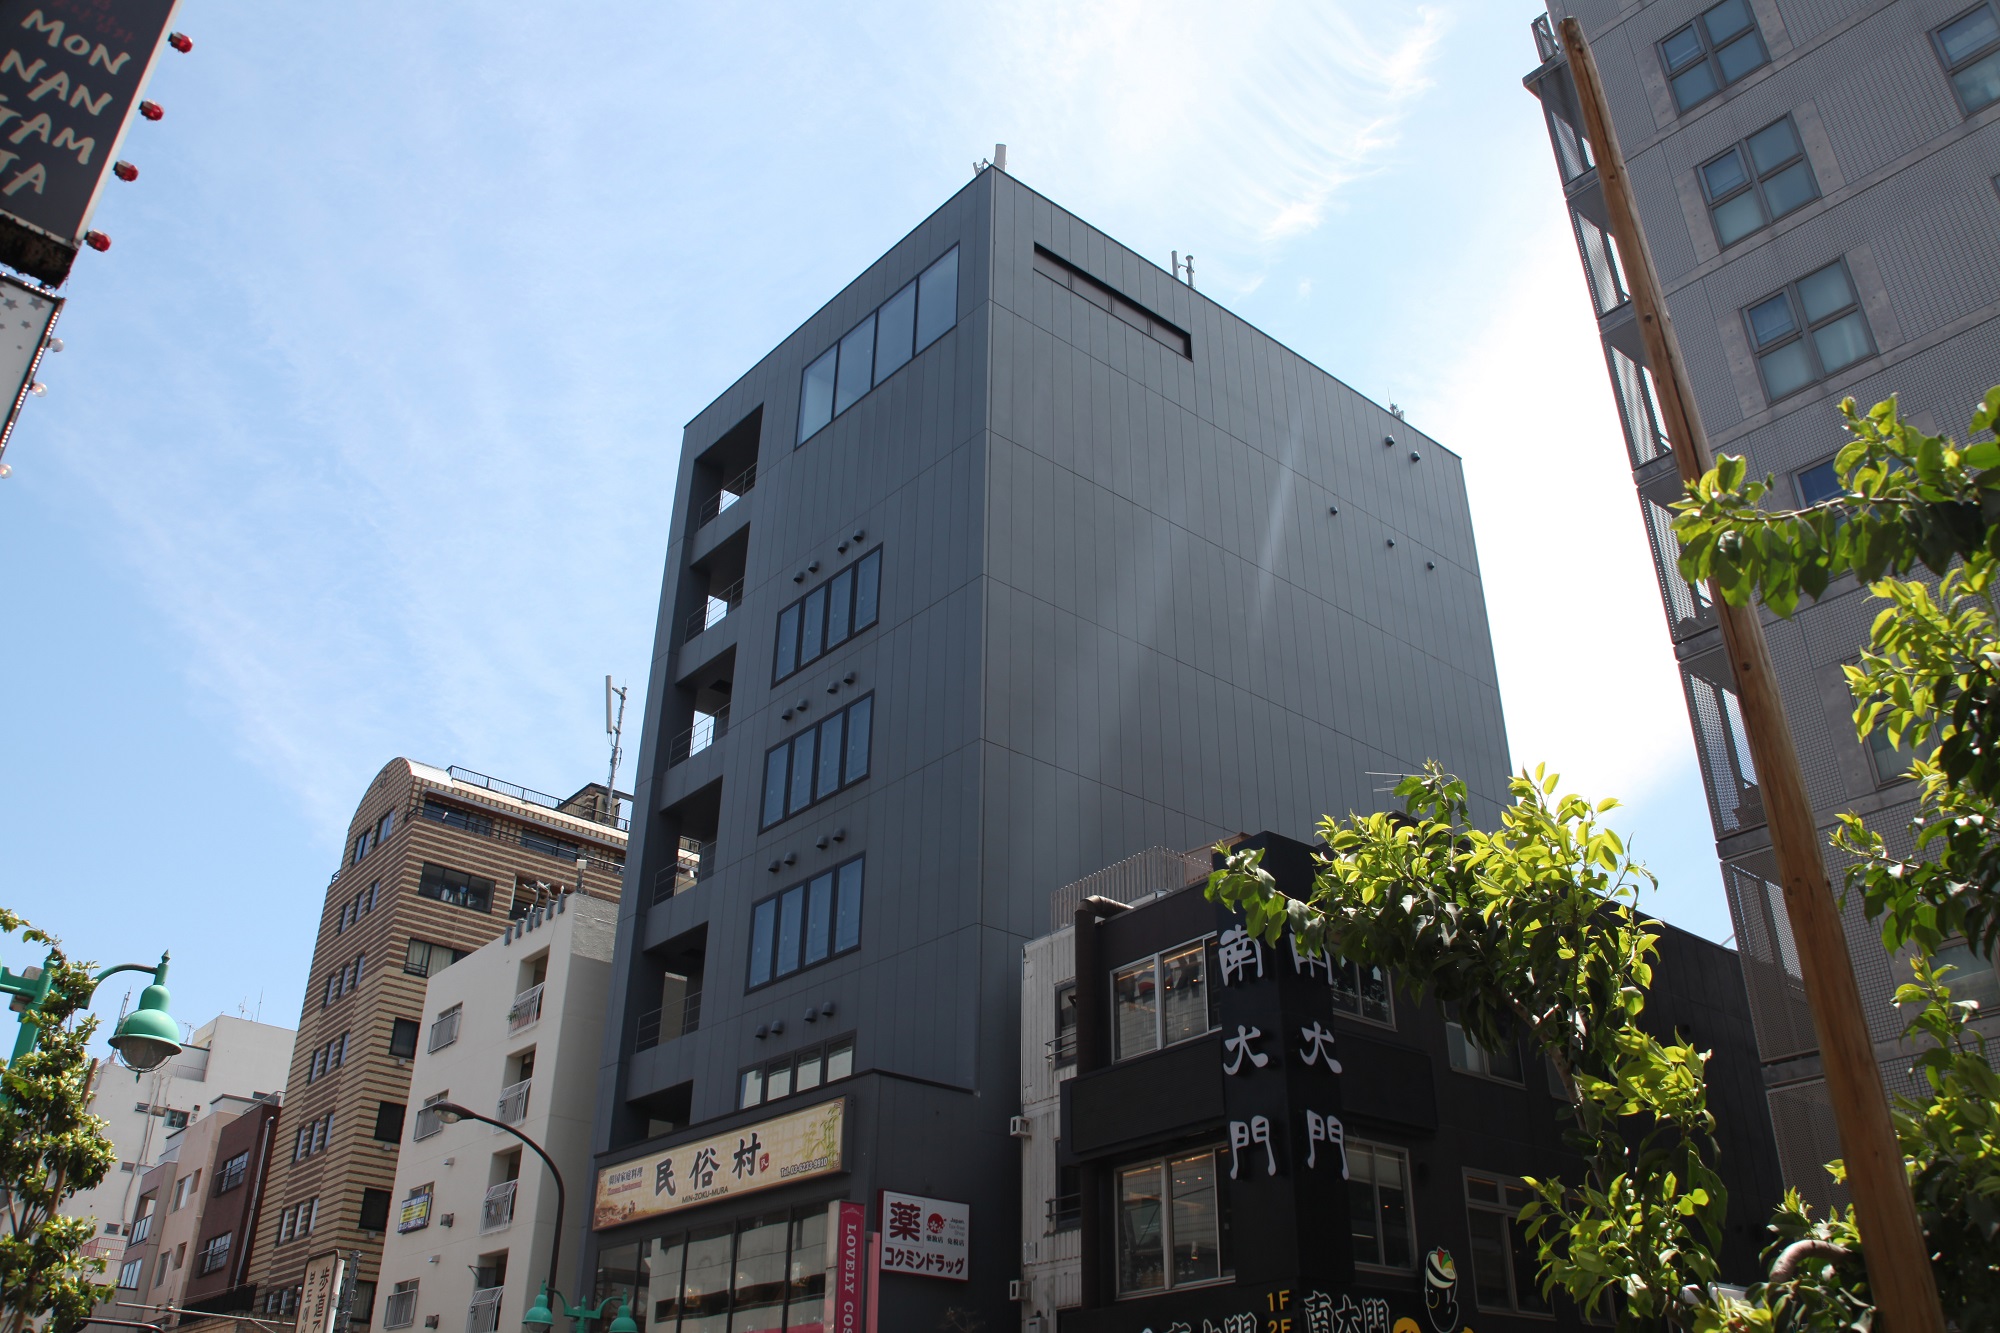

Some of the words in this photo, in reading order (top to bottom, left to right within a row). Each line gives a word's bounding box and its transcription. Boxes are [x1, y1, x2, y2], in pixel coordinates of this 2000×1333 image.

[21, 9, 131, 75] MON
[0, 48, 113, 116] NAN
[0, 93, 95, 165] TAM
[655, 1132, 762, 1197] 民俗村
[682, 1186, 728, 1204] MIN-ZOKU-MURA
[889, 1201, 921, 1242] 薬
[844, 1223, 857, 1294] LOVELY
[884, 1246, 965, 1275] コクミンドラッグ
[1266, 1289, 1290, 1312] 1F
